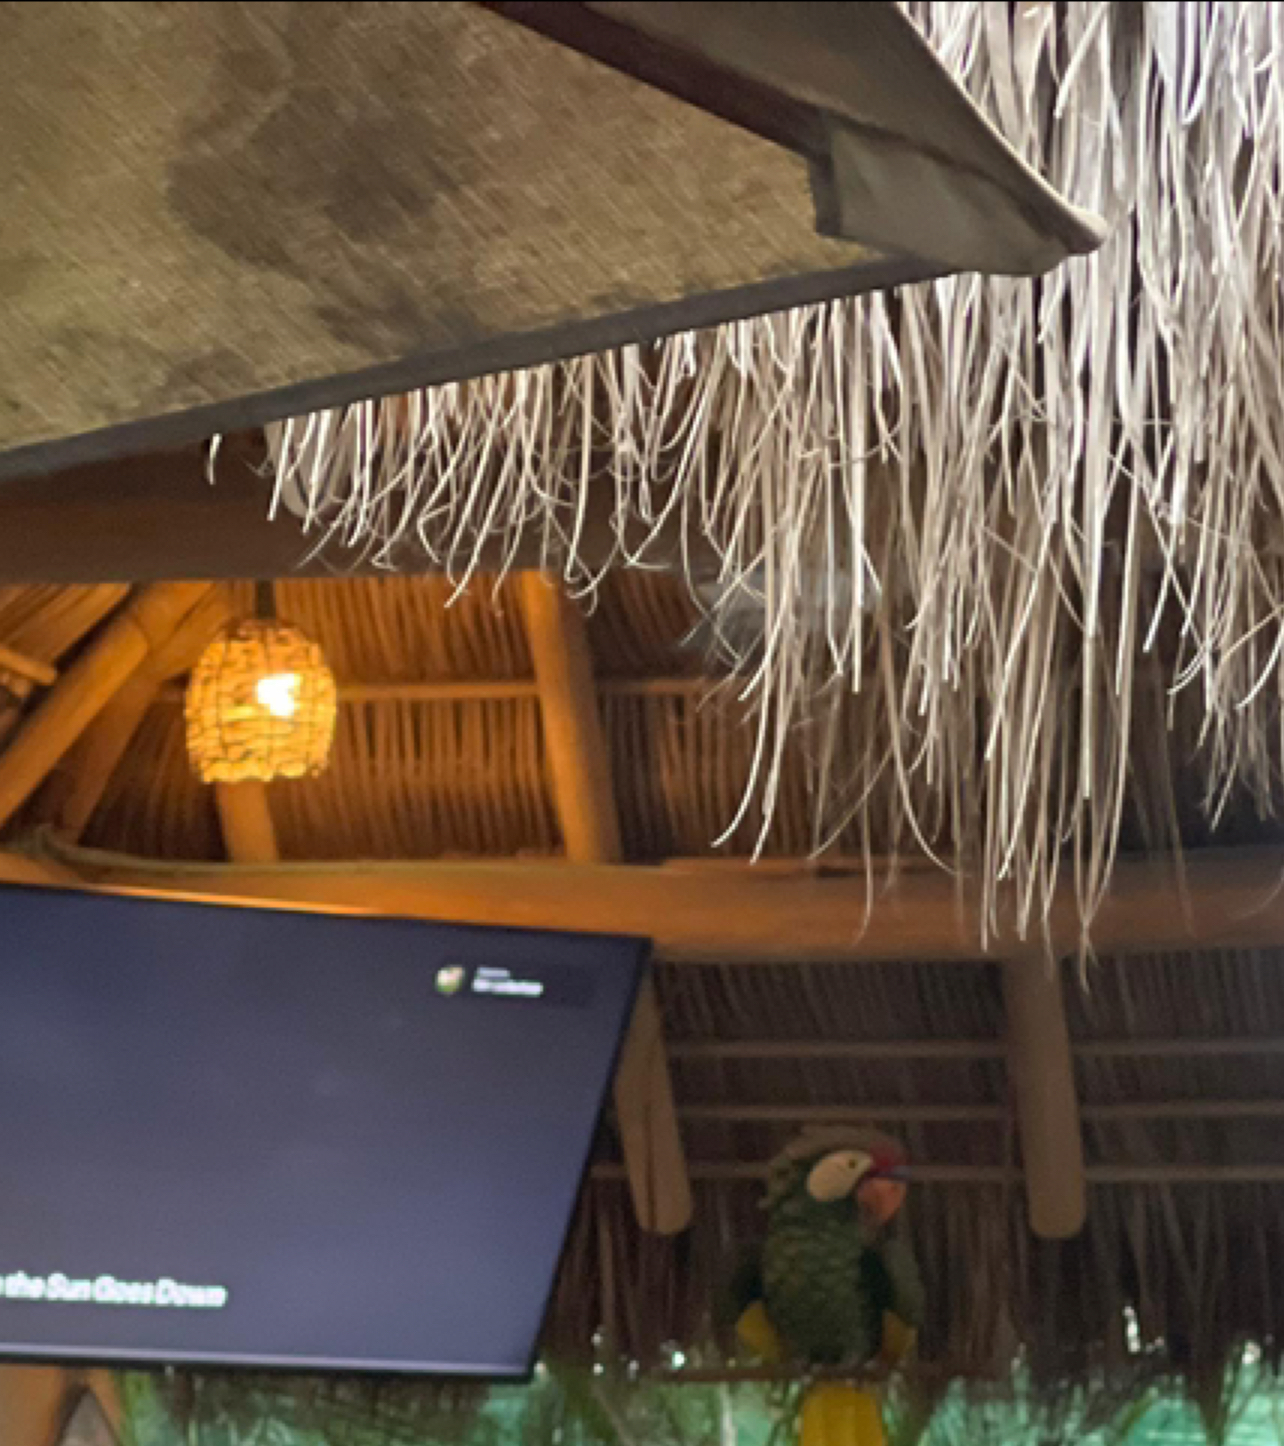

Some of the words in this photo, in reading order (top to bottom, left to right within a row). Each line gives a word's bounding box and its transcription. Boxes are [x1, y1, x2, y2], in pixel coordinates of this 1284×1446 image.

[4, 1269, 44, 1299] the
[45, 1271, 92, 1301] Sun
[156, 1276, 228, 1307] Down
